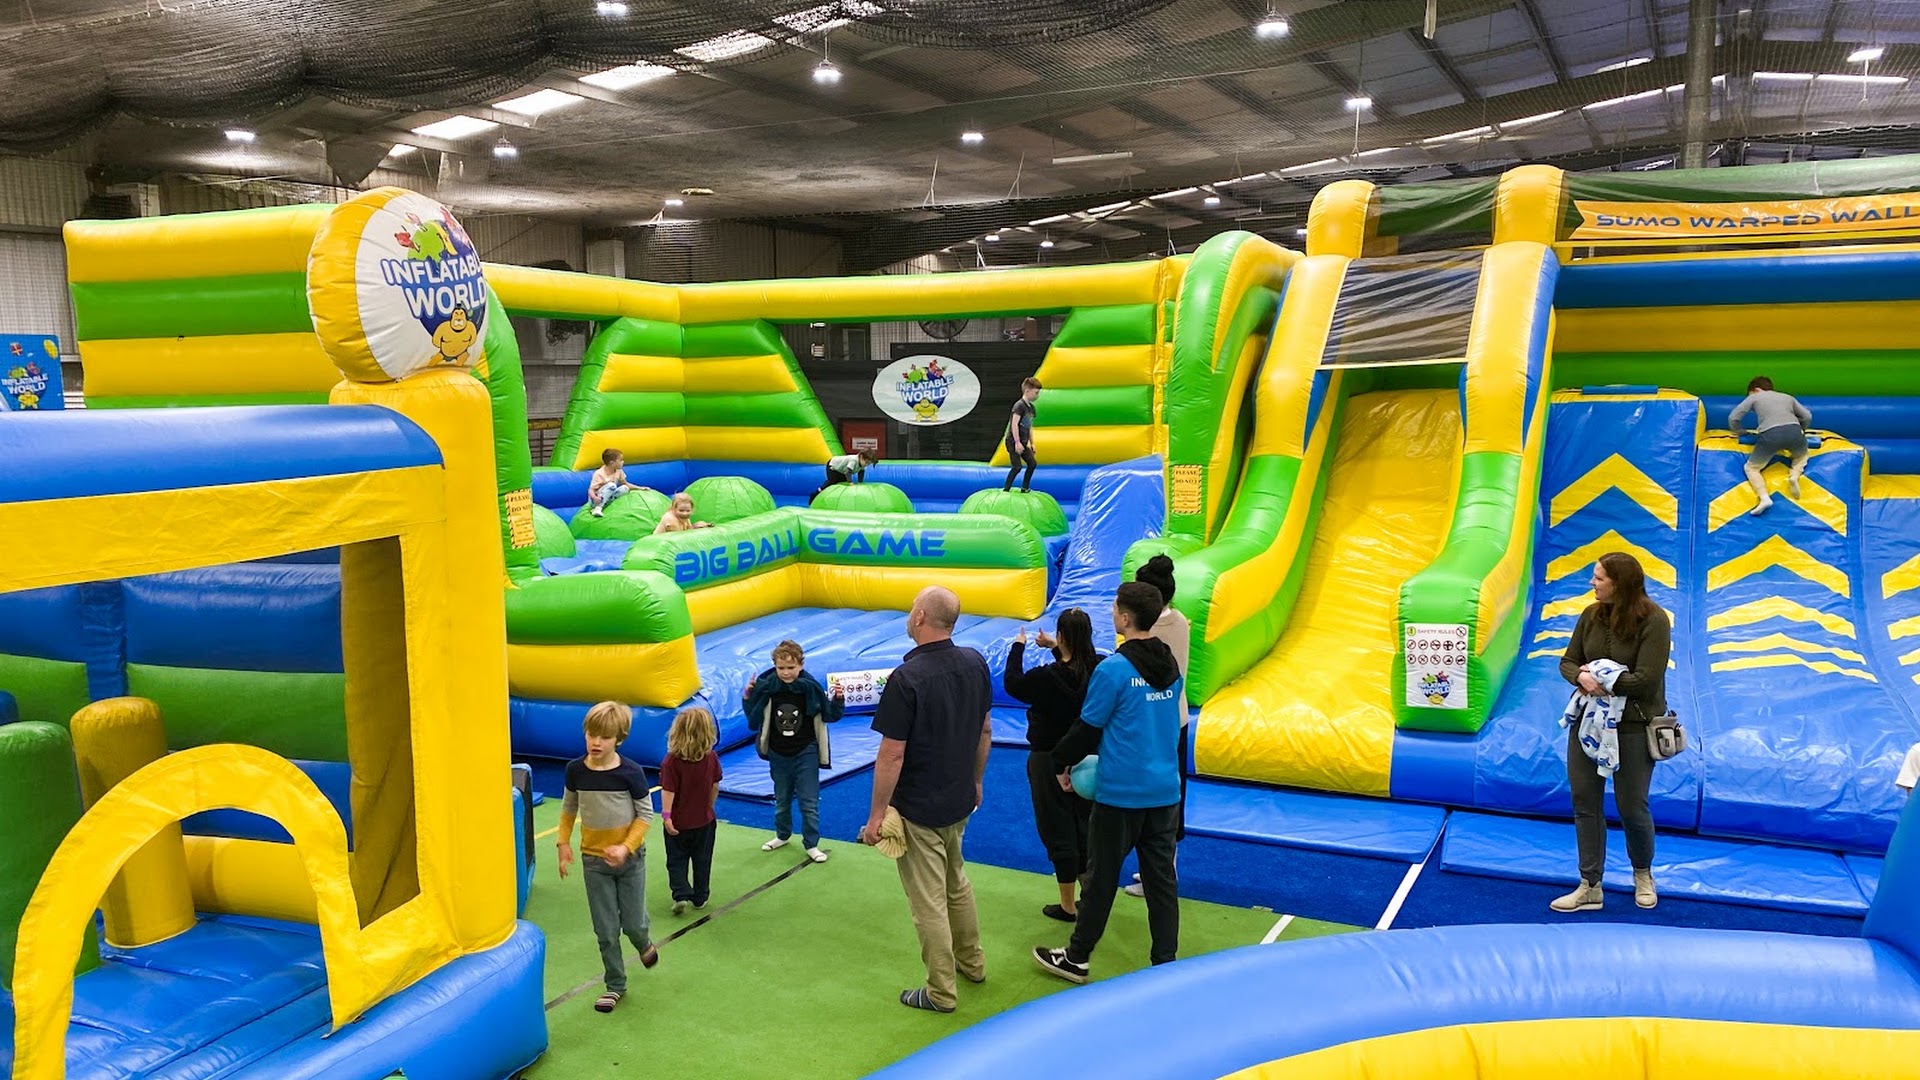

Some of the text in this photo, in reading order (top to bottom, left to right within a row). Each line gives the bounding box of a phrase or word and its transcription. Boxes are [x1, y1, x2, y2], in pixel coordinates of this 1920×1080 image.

[1596, 205, 1920, 228] SUMO WARPED WALL
[380, 255, 482, 286] INFLATABL
[404, 277, 487, 319] WORLD
[7, 382, 46, 395] WORLD
[895, 375, 954, 392] INFLATABLE
[901, 386, 949, 402] WORLD
[674, 527, 947, 583] BIG BALL GAME
